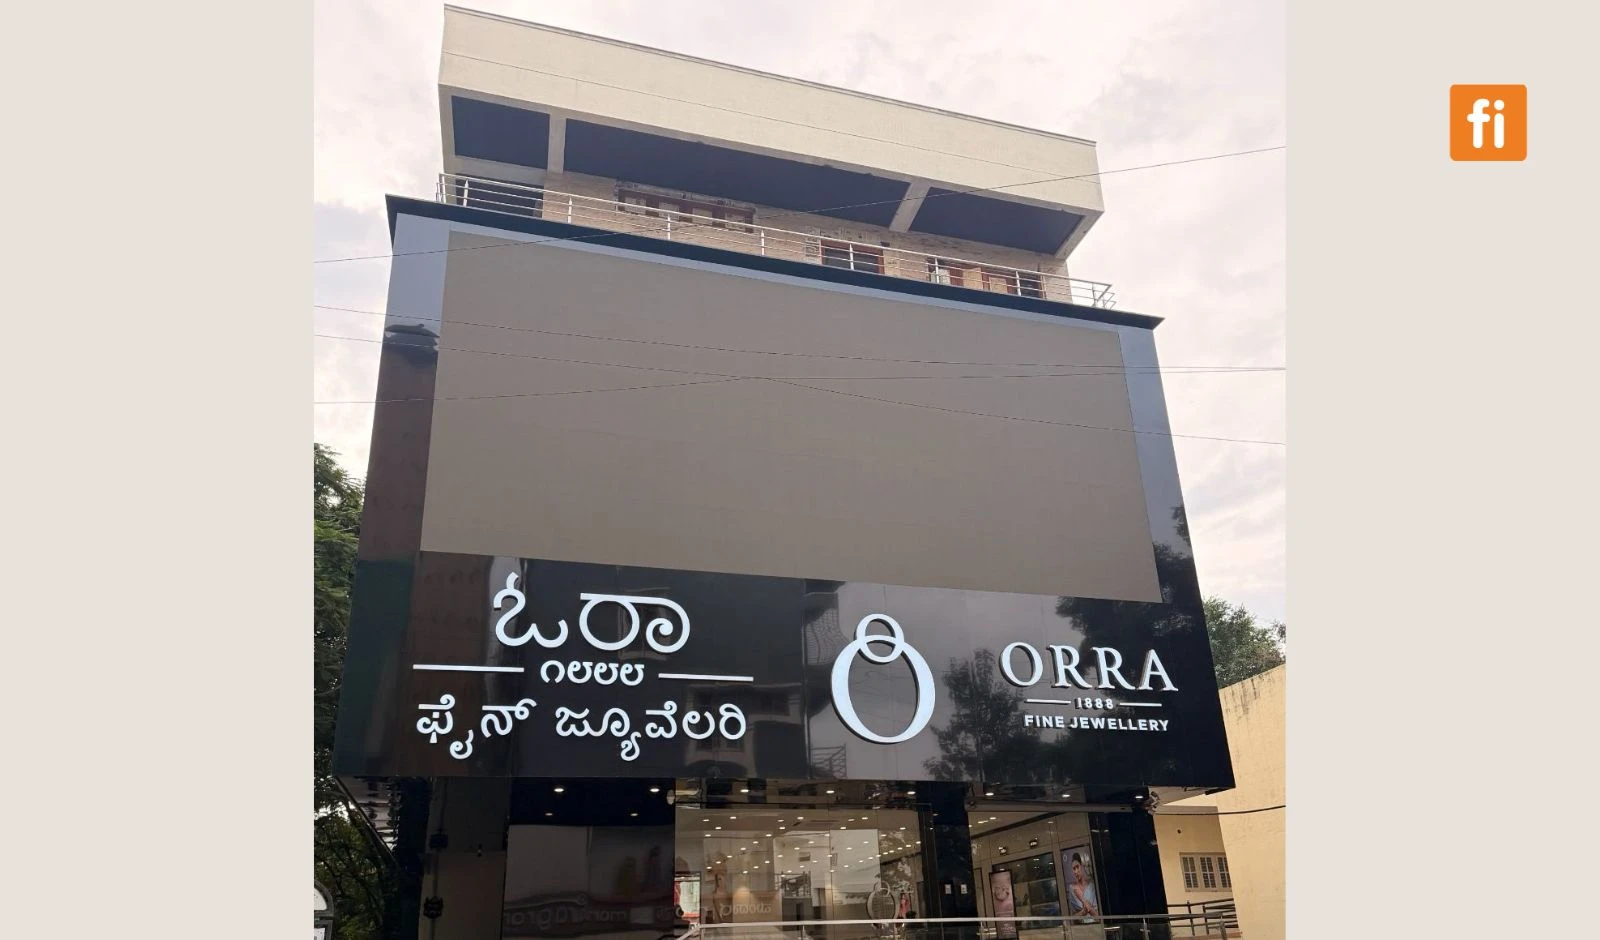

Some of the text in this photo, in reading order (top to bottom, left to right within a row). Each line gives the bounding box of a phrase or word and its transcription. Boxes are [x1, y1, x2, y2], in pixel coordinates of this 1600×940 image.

[493, 571, 691, 653] ಓರಾ
[1000, 641, 1179, 692] ORRA
[416, 693, 537, 760] ಫೈನ್
[1024, 714, 1169, 732] FINE JEWELLERY
[1075, 697, 1114, 710] 1888
